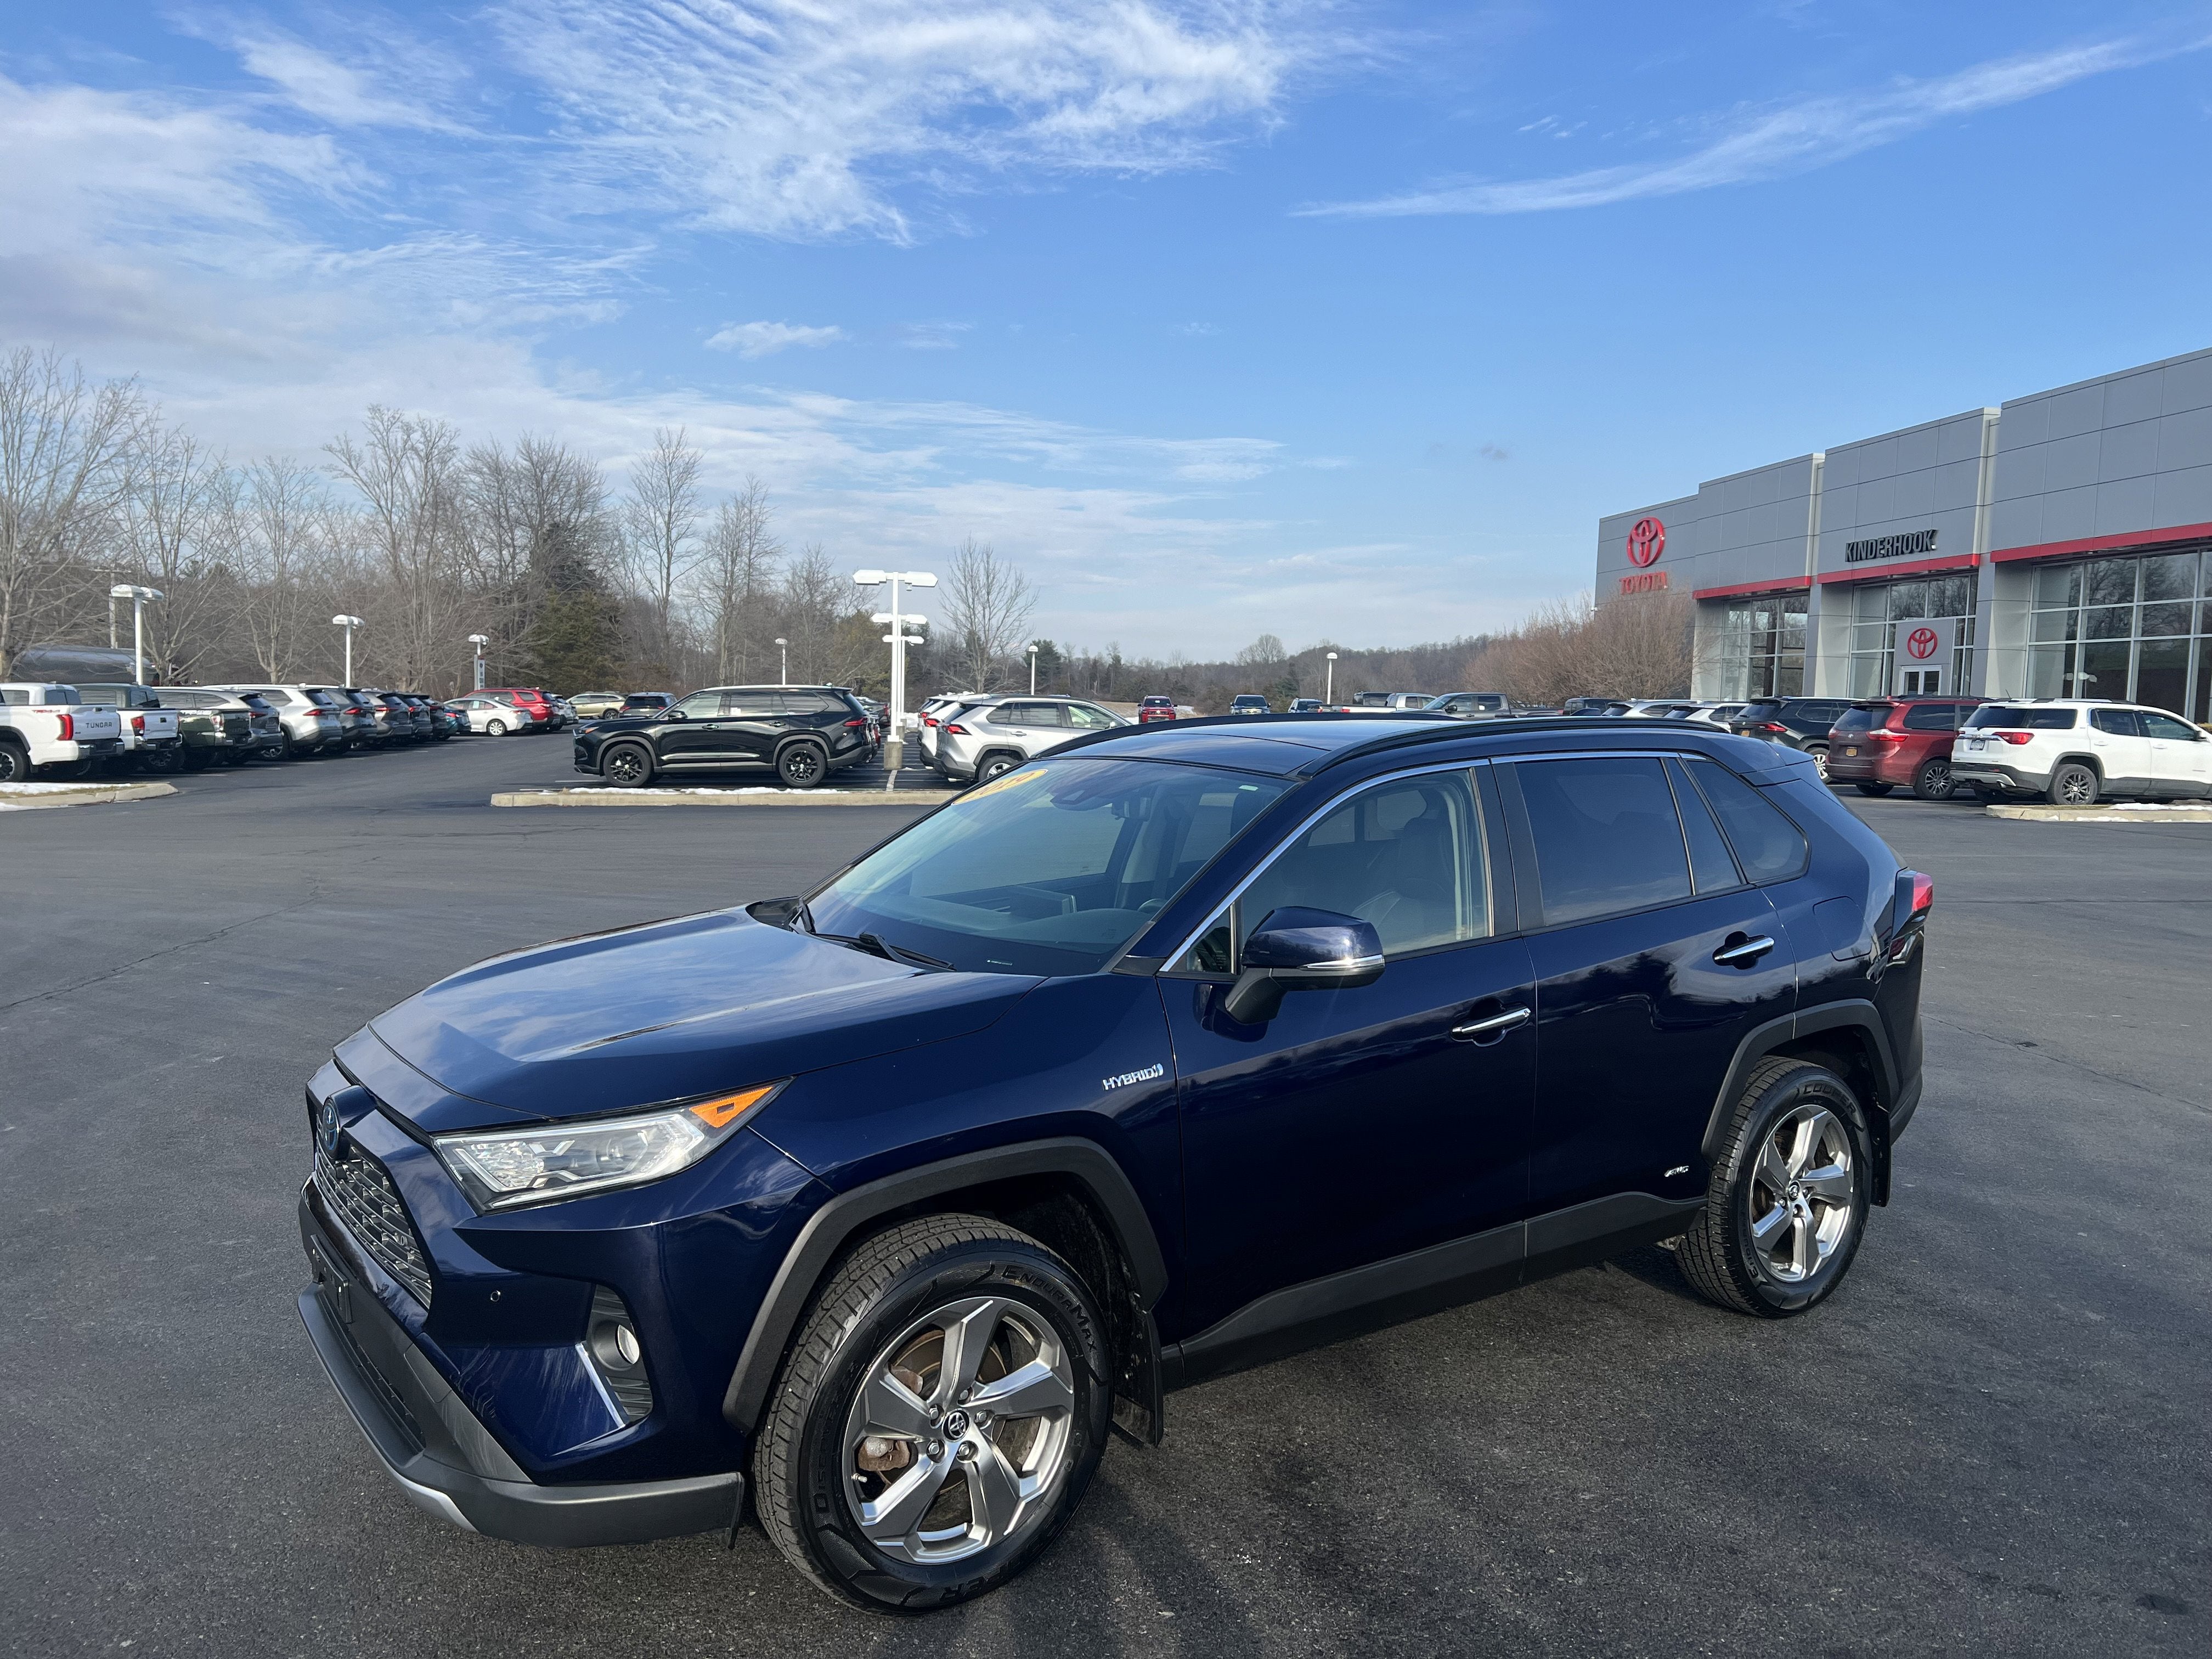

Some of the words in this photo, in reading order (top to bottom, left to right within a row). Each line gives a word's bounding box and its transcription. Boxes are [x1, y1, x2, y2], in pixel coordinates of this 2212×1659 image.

[1845, 529, 1939, 562] KINDERHOOK
[1619, 571, 1667, 595] TOYOTA
[1102, 1065, 1159, 1091] HYBRID
[1802, 1083, 1857, 1115] COOPER
